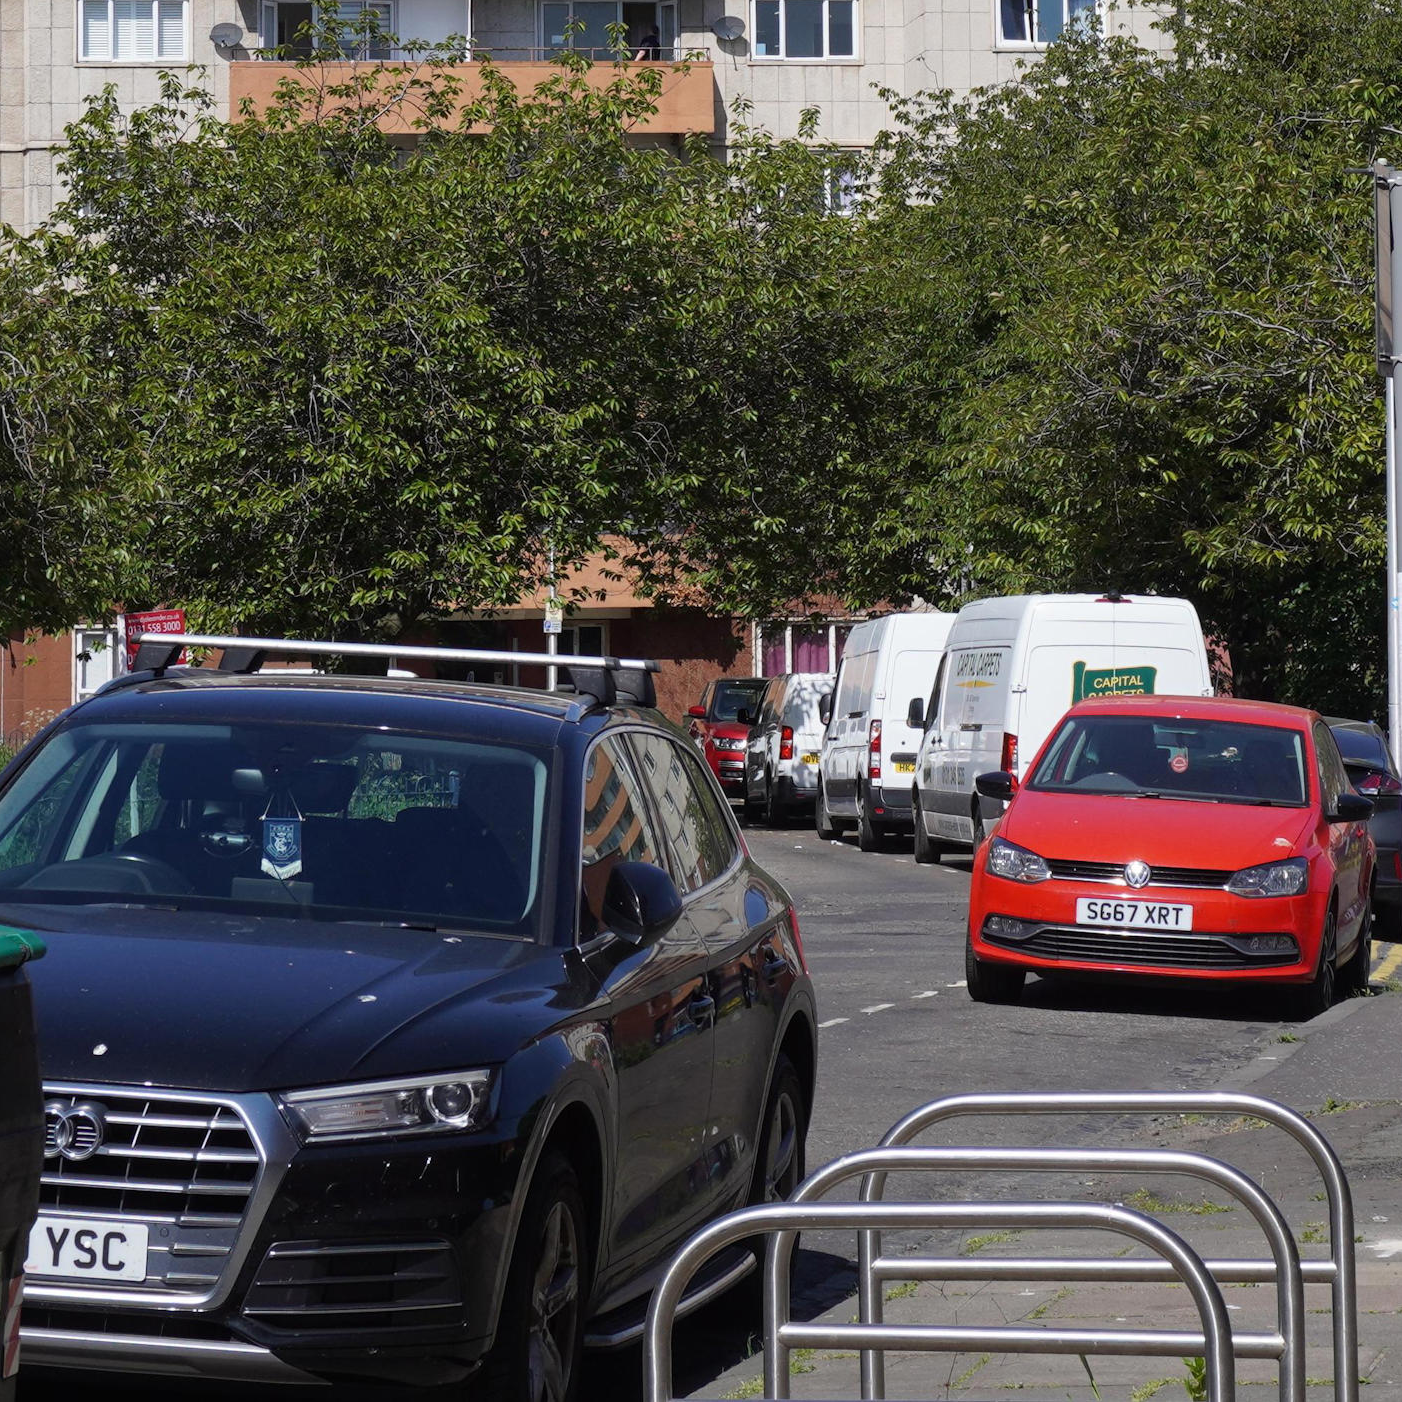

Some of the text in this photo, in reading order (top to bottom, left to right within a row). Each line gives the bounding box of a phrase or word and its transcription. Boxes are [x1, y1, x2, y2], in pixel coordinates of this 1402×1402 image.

[128, 621, 181, 636] 0131 558 3000
[1094, 675, 1144, 688] CAPITAL
[1087, 901, 1183, 926] SG67 XRT
[46, 1226, 127, 1272] YSC
